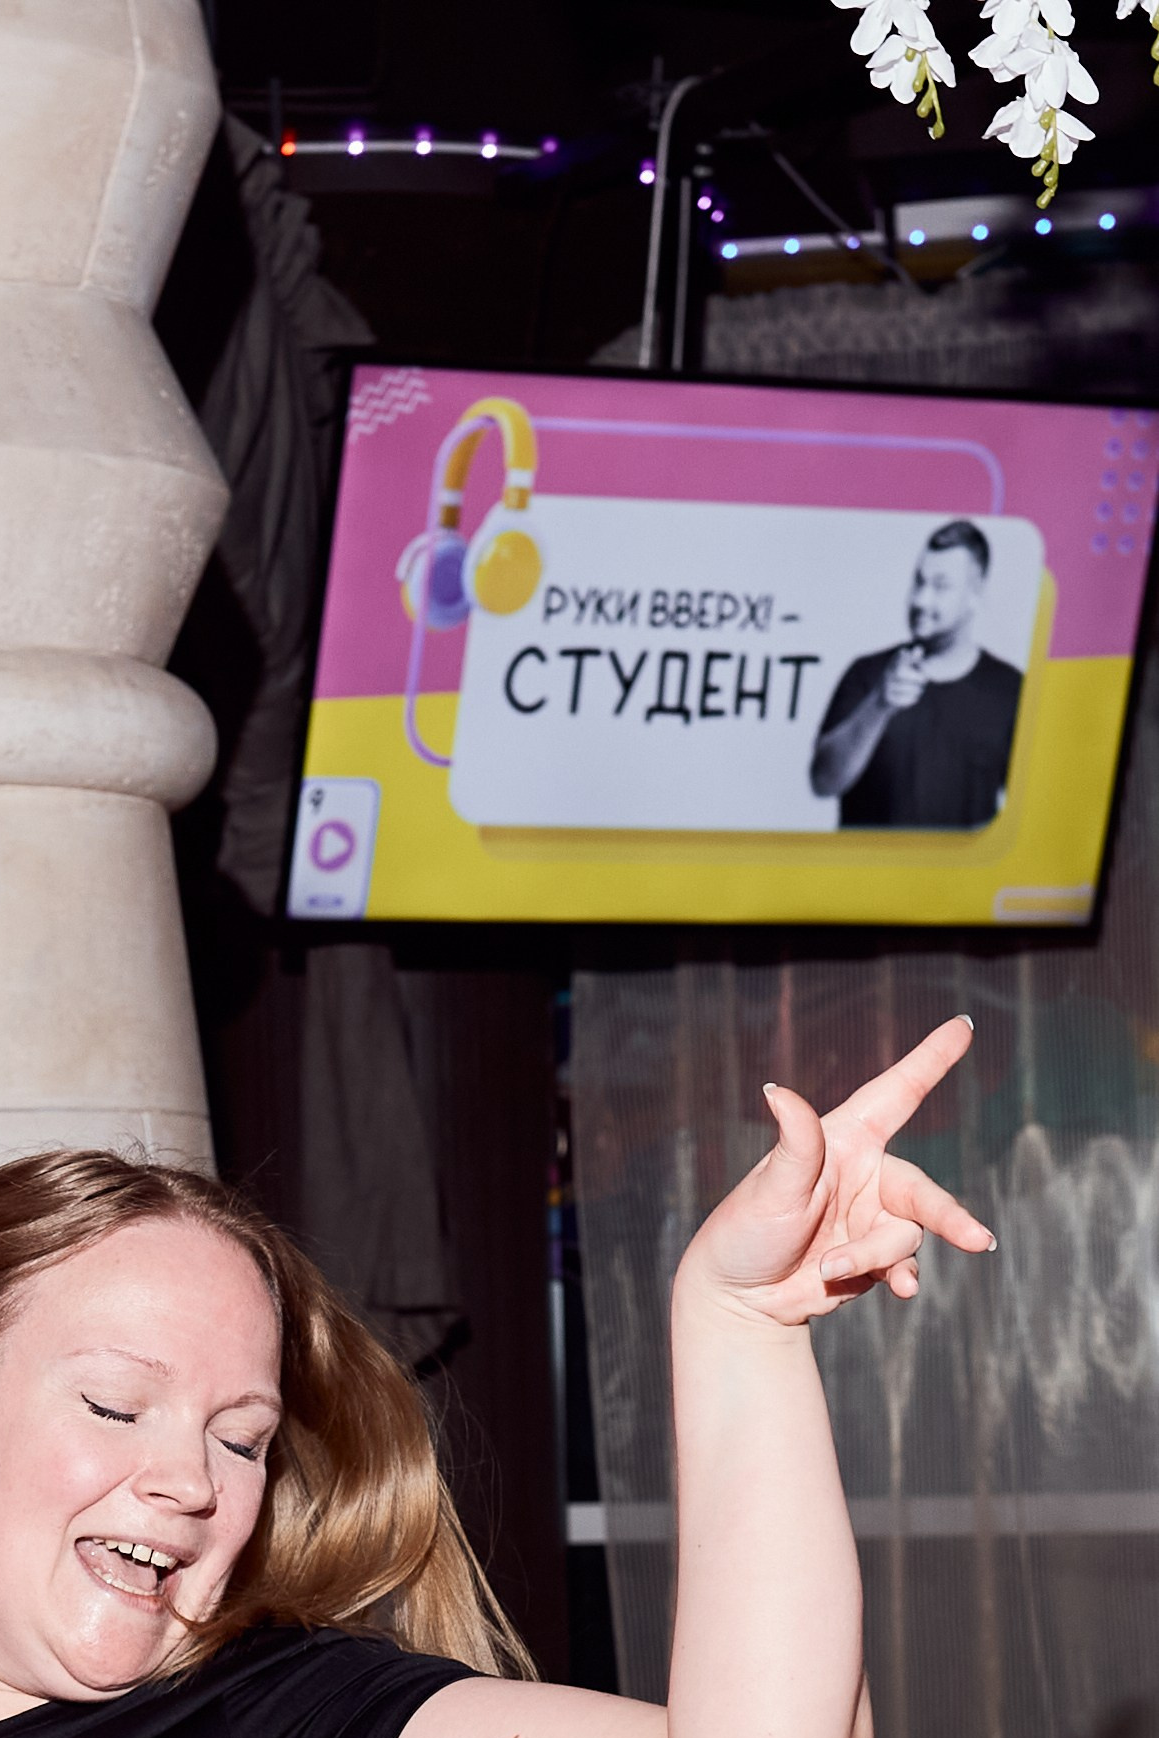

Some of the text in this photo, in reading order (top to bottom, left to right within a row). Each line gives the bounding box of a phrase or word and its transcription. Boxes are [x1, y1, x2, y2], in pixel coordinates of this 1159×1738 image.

[543, 585, 640, 625] РУКИ
[649, 589, 774, 631] ВВЕРХ!
[504, 646, 821, 726] СТУДЕНТ
